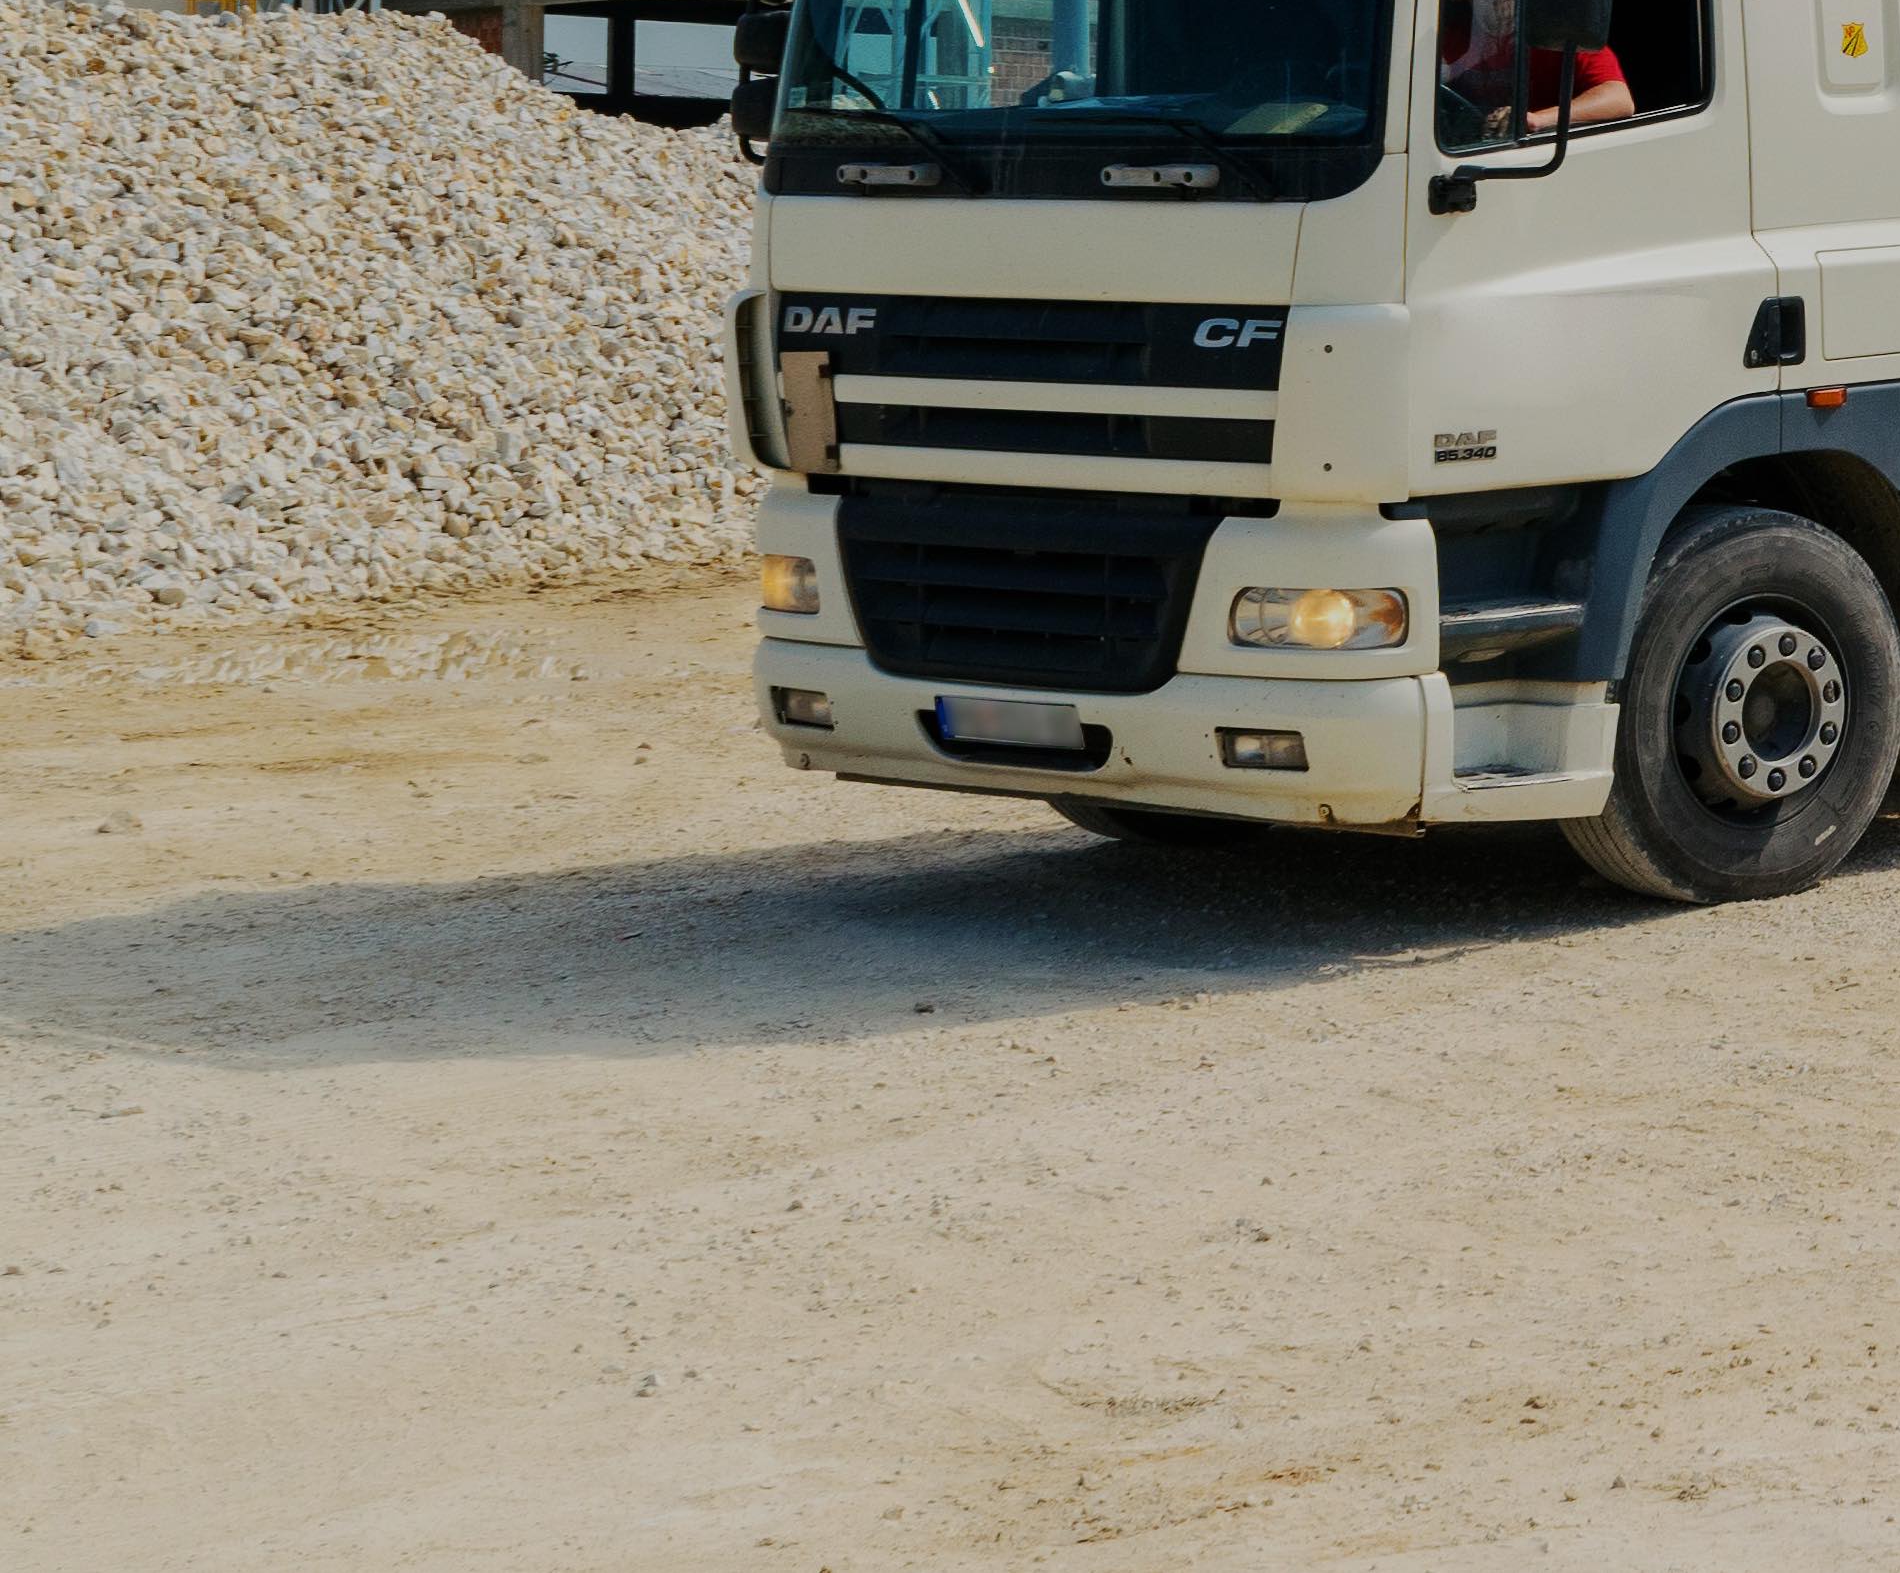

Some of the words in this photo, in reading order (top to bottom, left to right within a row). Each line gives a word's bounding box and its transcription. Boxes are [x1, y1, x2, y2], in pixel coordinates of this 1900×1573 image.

[783, 305, 878, 335] DAF
[1193, 317, 1284, 348] CF
[1434, 429, 1497, 448] DAF
